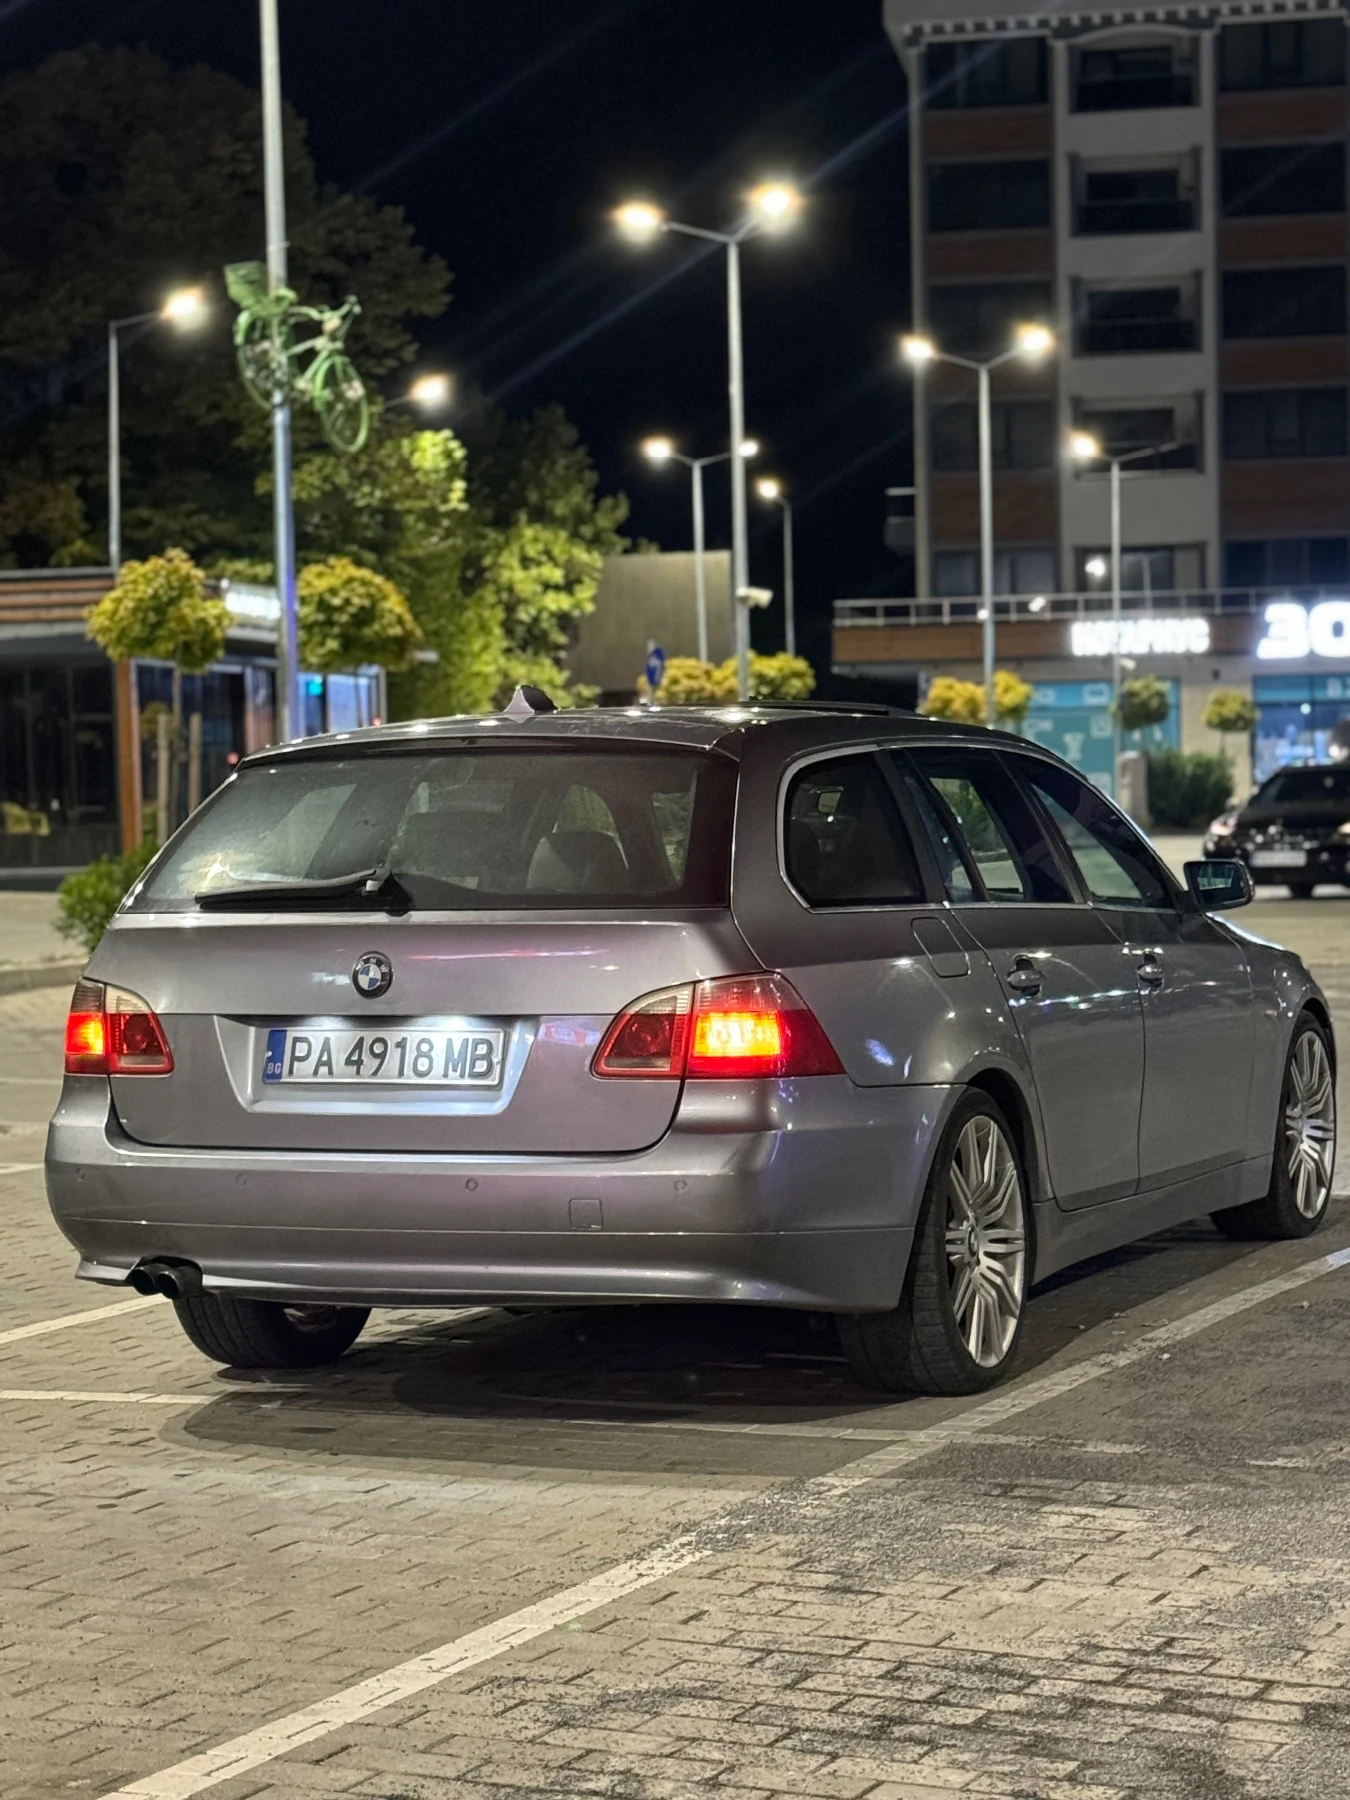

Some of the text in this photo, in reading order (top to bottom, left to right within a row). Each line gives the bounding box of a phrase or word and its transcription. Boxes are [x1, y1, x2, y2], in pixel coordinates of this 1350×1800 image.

[266, 1036, 494, 1080] BG PA 4918 MB
